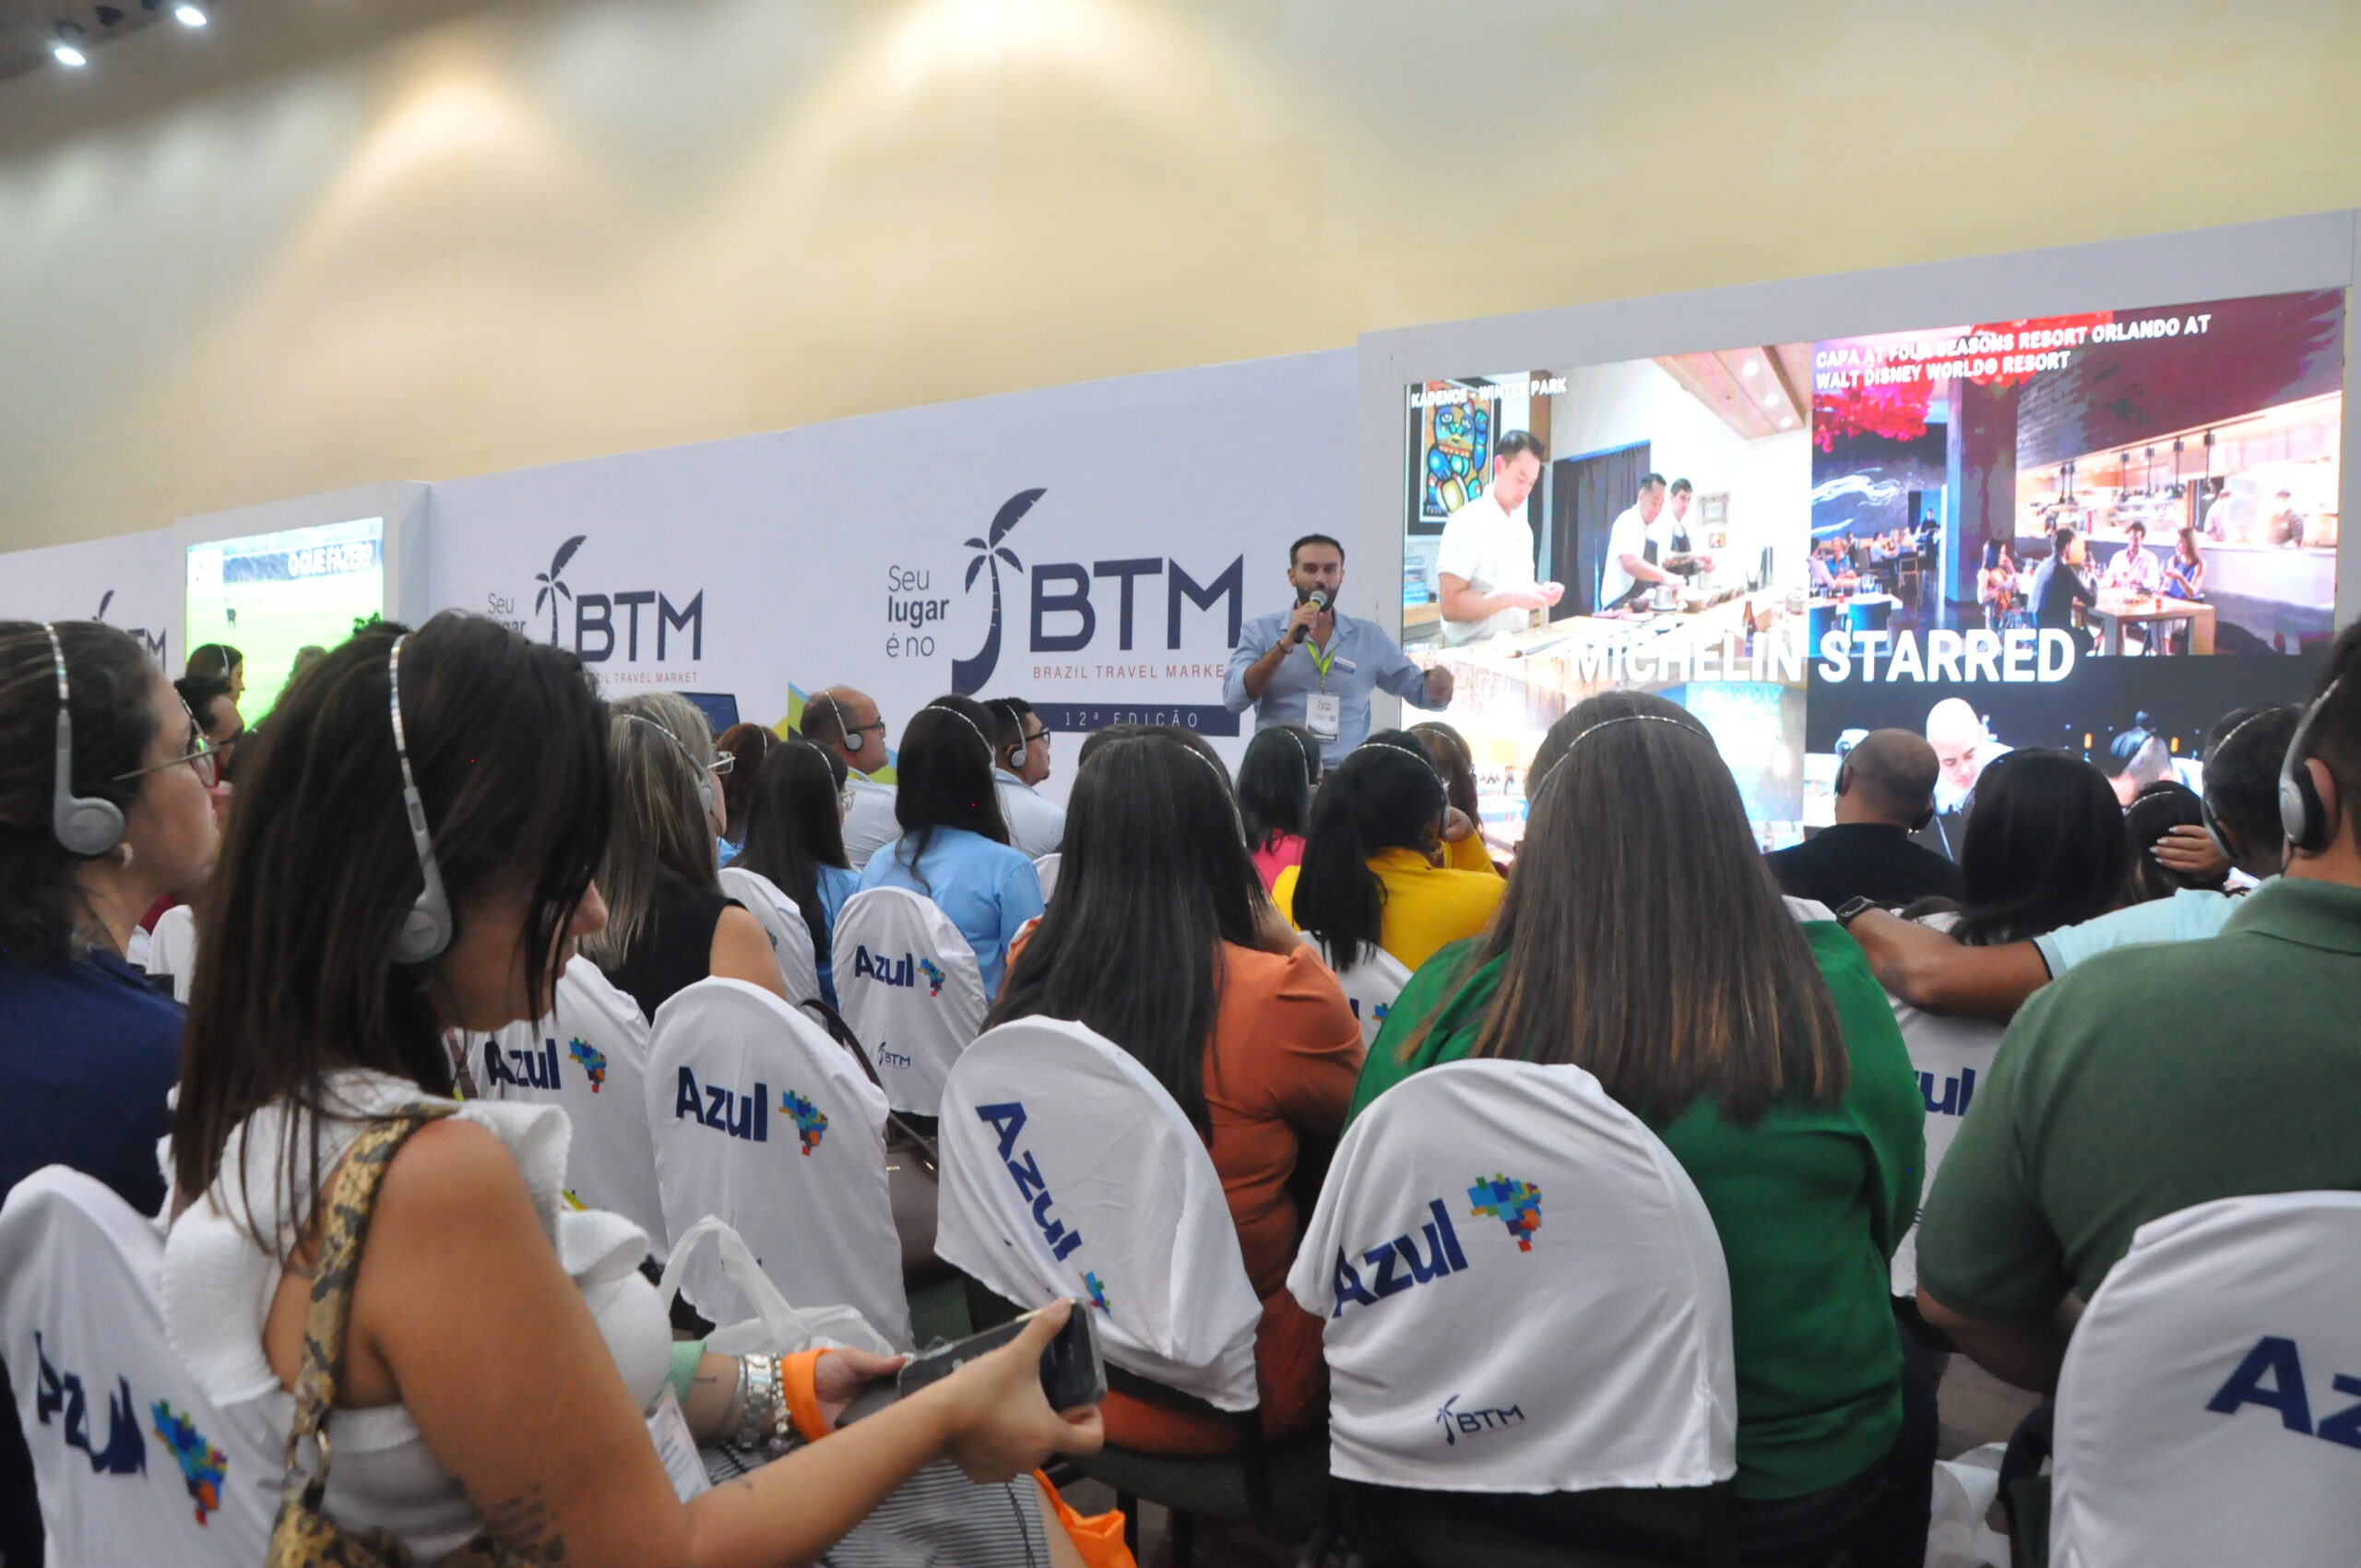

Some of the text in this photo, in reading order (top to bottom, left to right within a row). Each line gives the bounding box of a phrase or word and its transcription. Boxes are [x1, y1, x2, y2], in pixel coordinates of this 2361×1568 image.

[1816, 315, 2212, 369] CAPA AT FOUR SEASONS RESORT ORLANDO AT
[1531, 377, 1567, 397] PARK
[1816, 370, 1860, 390] WALT
[1864, 365, 1922, 386] DISNEY
[2002, 350, 2070, 374] RESORT
[888, 564, 930, 592] Seu
[487, 592, 514, 614] Seu
[888, 595, 950, 628] lugar
[1030, 552, 1243, 652] BTM
[575, 588, 703, 662] BTM
[886, 632, 934, 658] é no
[1033, 664, 1224, 679] BRAZIL TRAVEL MARKE
[1570, 627, 2076, 683] MICHELIN STARRED
[614, 672, 651, 683] TRAVEL
[656, 671, 698, 683] MARKET
[855, 944, 914, 987] Azul
[484, 1039, 561, 1089] Azul
[885, 1051, 910, 1067] BTM
[676, 1066, 767, 1142] Azul
[1915, 1066, 1975, 1117] ul
[975, 1101, 1082, 1262] Azul
[1333, 1198, 1468, 1318] Azul
[35, 1329, 148, 1479] Azul
[1456, 1403, 1525, 1433] BTM
